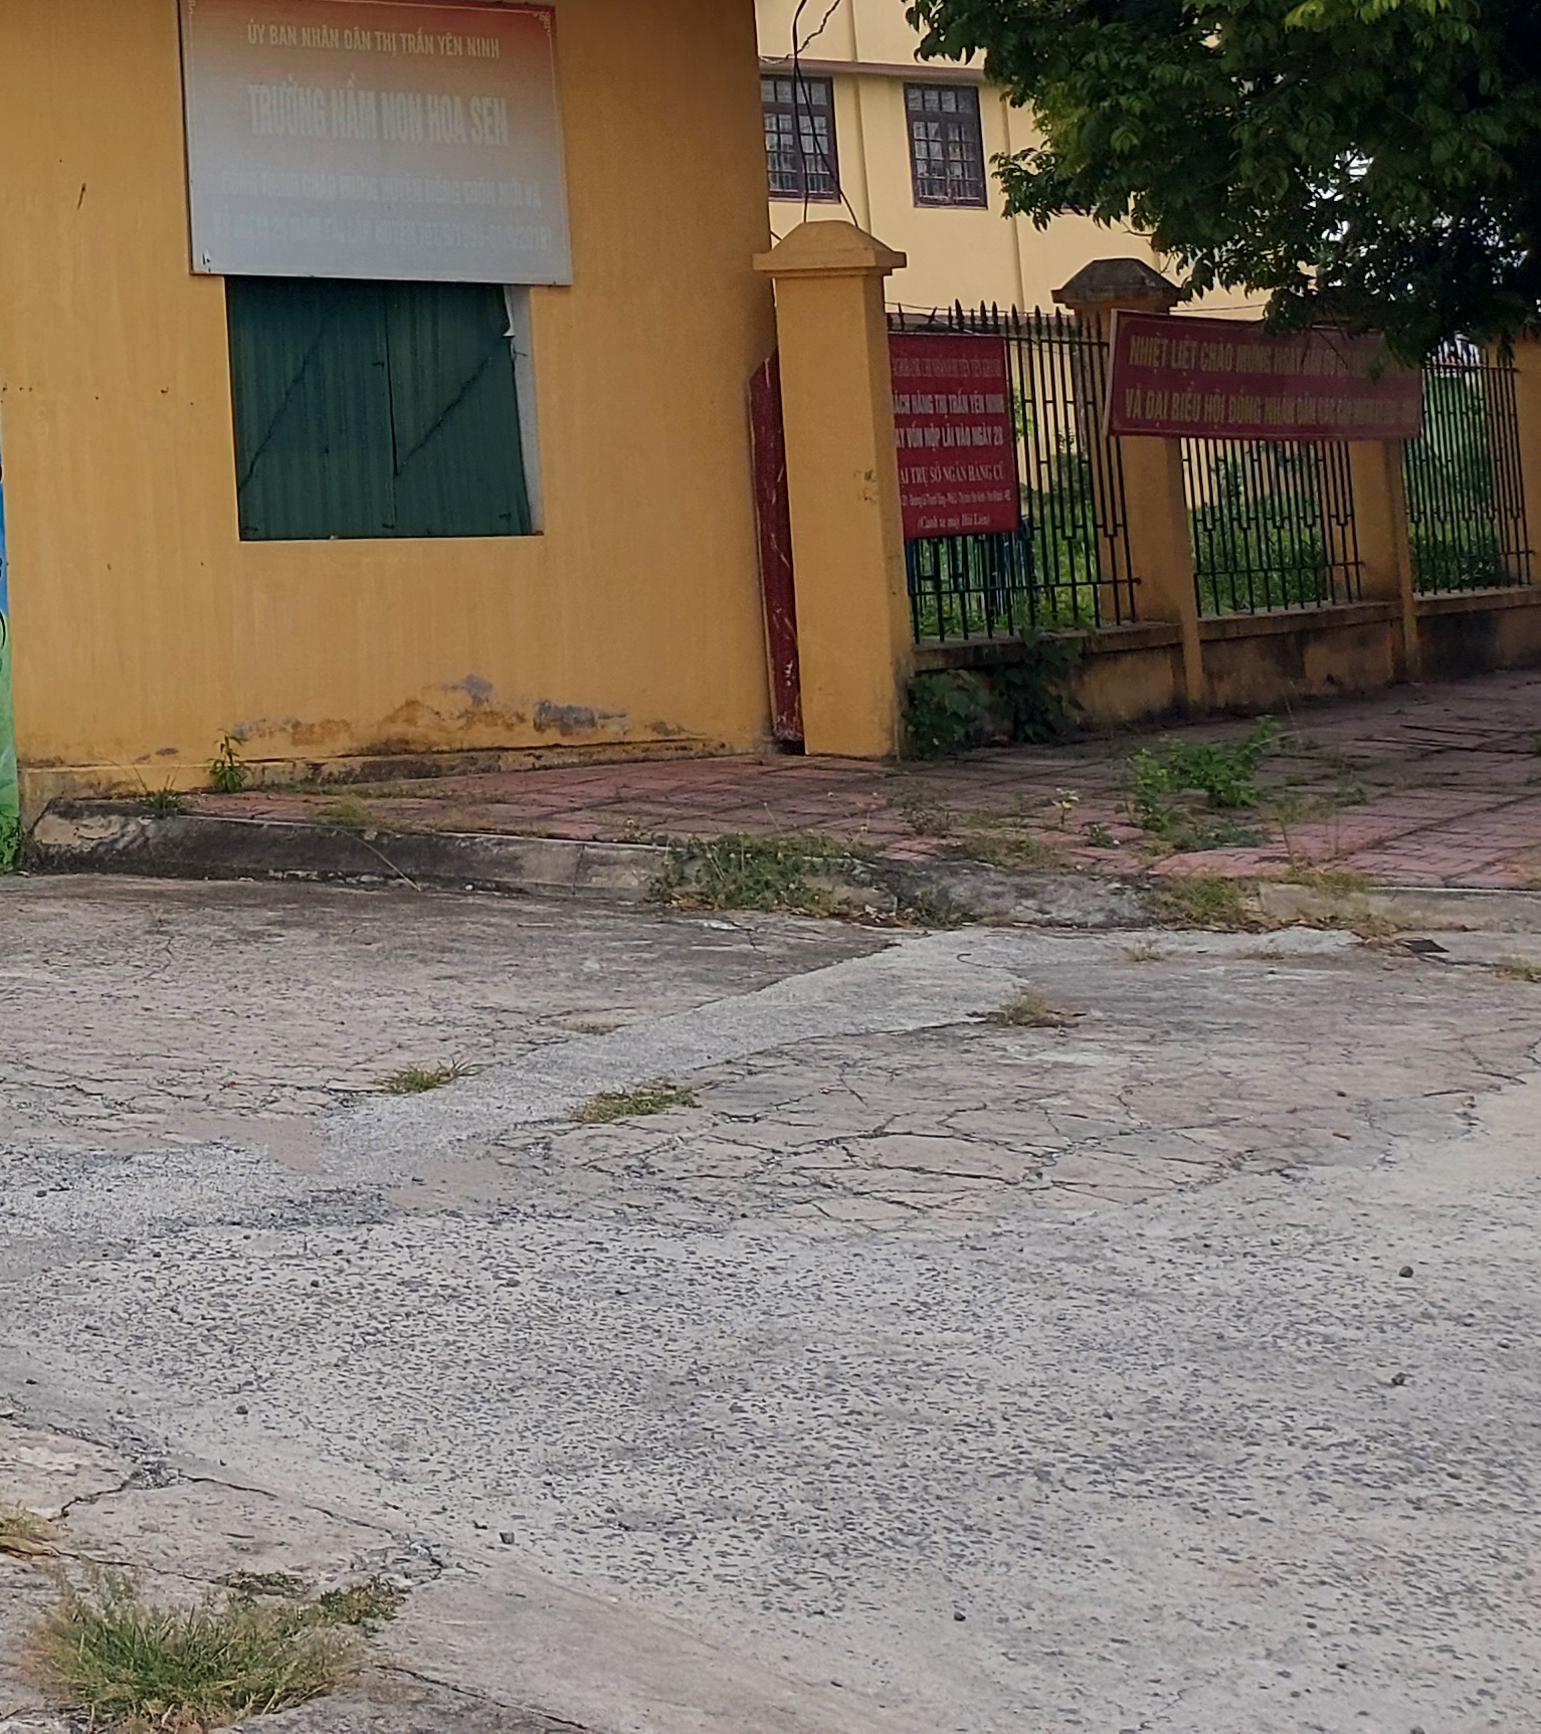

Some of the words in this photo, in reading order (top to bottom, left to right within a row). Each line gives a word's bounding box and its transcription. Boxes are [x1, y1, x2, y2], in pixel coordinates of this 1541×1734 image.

[269, 23, 297, 46] BAN
[301, 24, 340, 49] NHÂN
[373, 30, 397, 56] THỊ
[437, 32, 464, 56] YÊN
[467, 36, 500, 59] NINH
[469, 95, 509, 147] SEN
[1129, 332, 1169, 375] NHIỆT
[1125, 383, 1142, 419] VÀ
